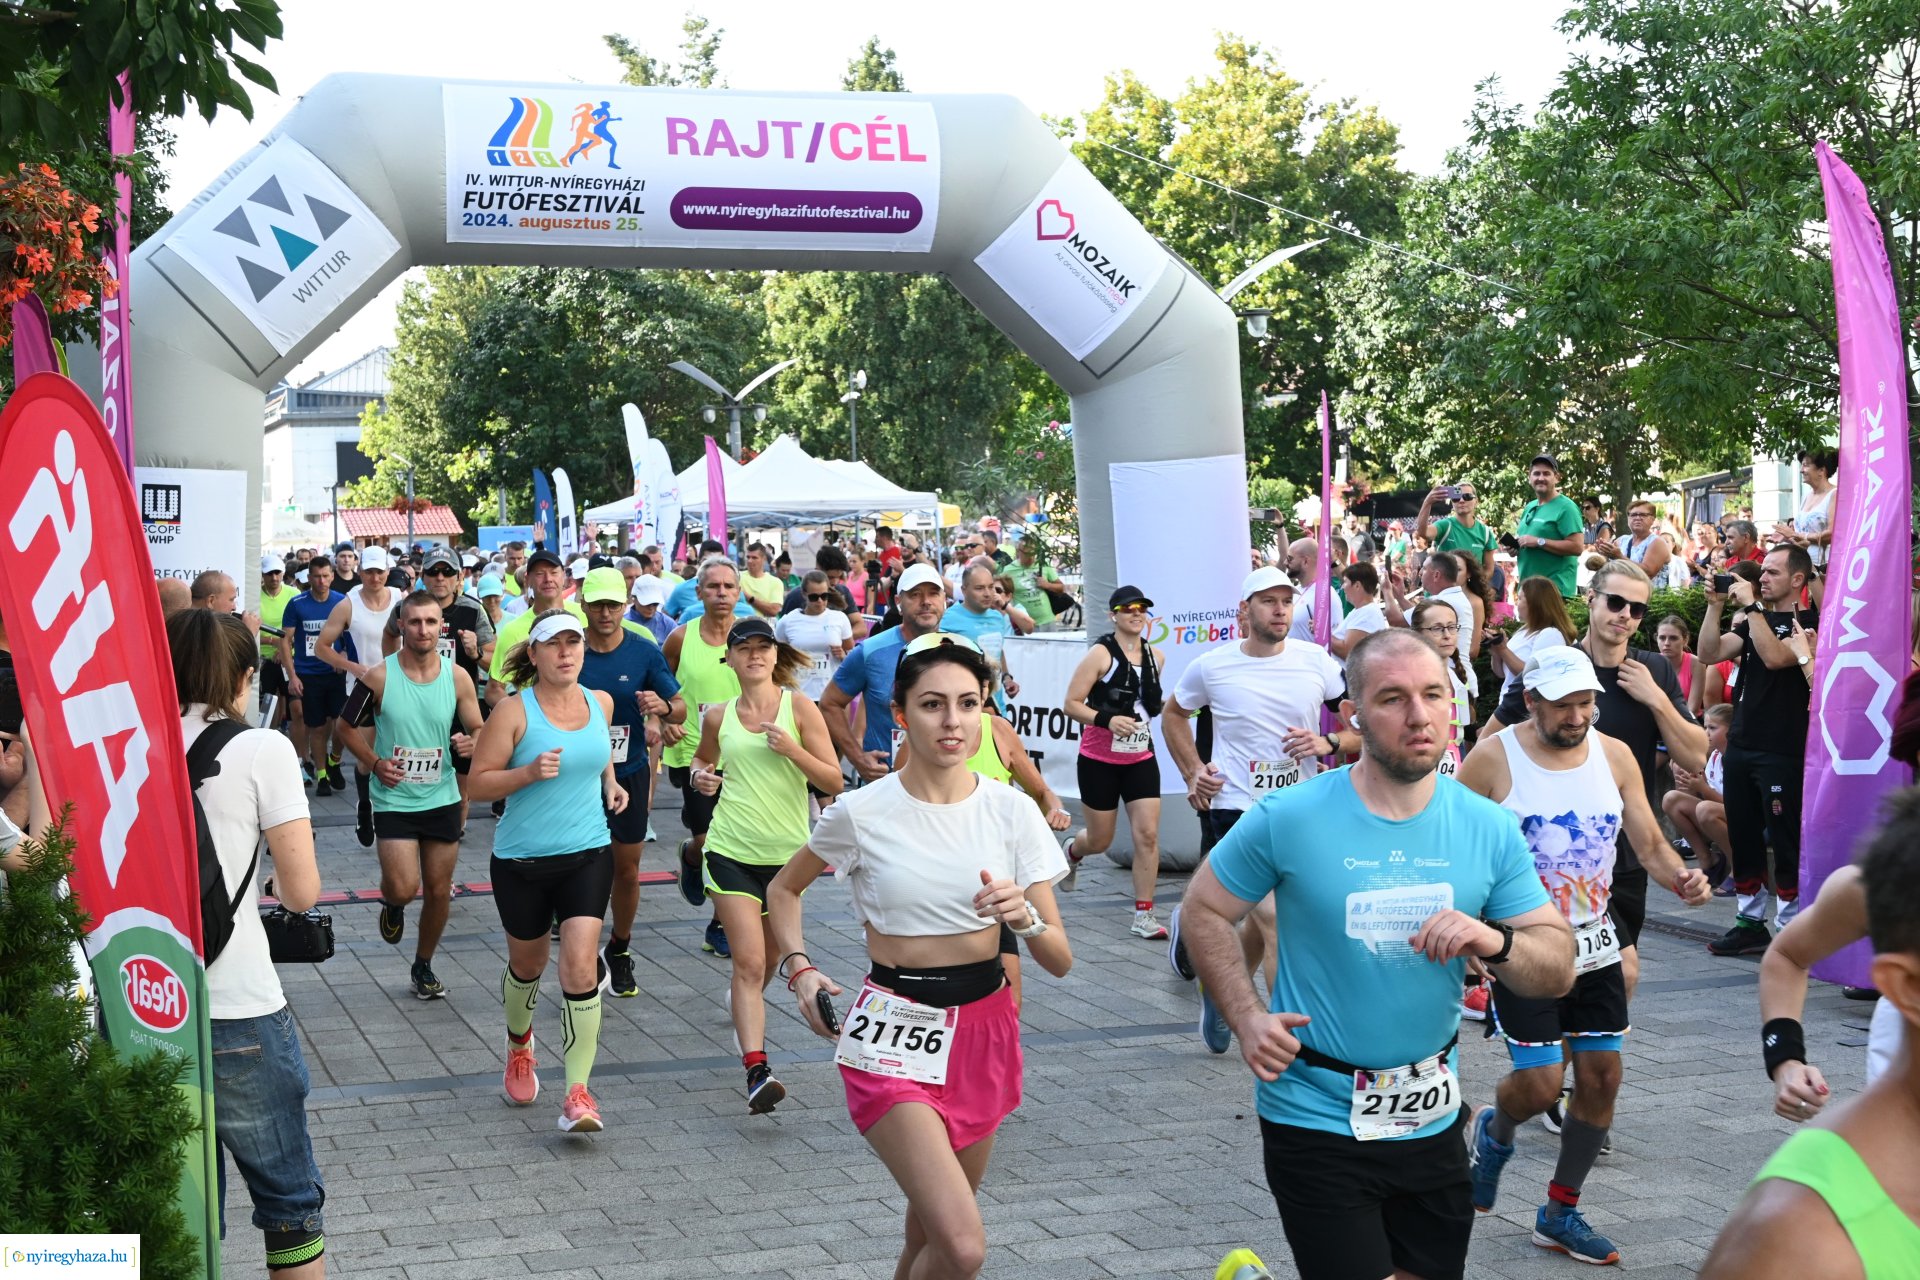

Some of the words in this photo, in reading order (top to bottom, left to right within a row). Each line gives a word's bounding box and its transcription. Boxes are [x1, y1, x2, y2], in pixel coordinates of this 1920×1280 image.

[665, 114, 927, 163] RAJT/CÉL
[465, 173, 484, 186] IV.
[488, 174, 646, 191] WITTUR-NYÍREGYHÁZI
[463, 189, 646, 214] FUTÓFESZTIVÁL
[683, 203, 911, 220] www.nyiregyhazifutofesztival.hu
[462, 212, 514, 228] 2024.
[519, 216, 611, 232] augusztus
[615, 216, 643, 231] 25.
[292, 249, 352, 304] WITTUR
[1068, 232, 1136, 299] MOZAIK
[1105, 286, 1126, 306] med
[148, 535, 174, 544] WHP
[1173, 623, 1235, 645] Többet
[1005, 703, 1086, 741] ORTOL
[1254, 768, 1299, 789] 21000
[848, 1014, 945, 1055] 21156
[1361, 1079, 1451, 1116] 21201
